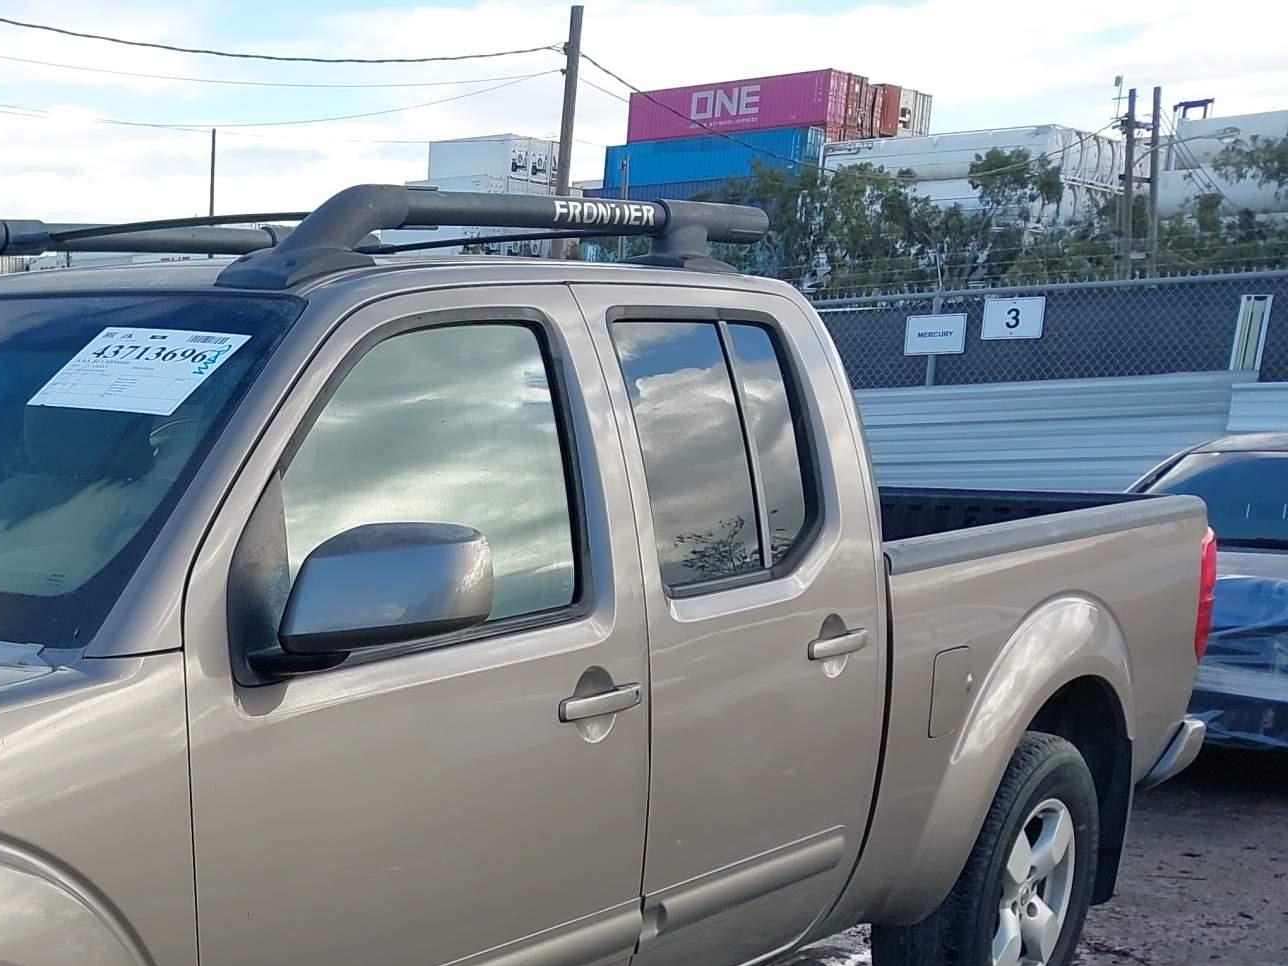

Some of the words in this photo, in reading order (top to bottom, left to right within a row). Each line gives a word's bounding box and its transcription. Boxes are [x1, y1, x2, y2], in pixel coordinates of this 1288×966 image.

[690, 84, 761, 120] ONE
[553, 200, 655, 226] FRONTIER
[1005, 308, 1020, 329] 3
[917, 330, 954, 338] MERCURY
[92, 344, 211, 363] 43713696
